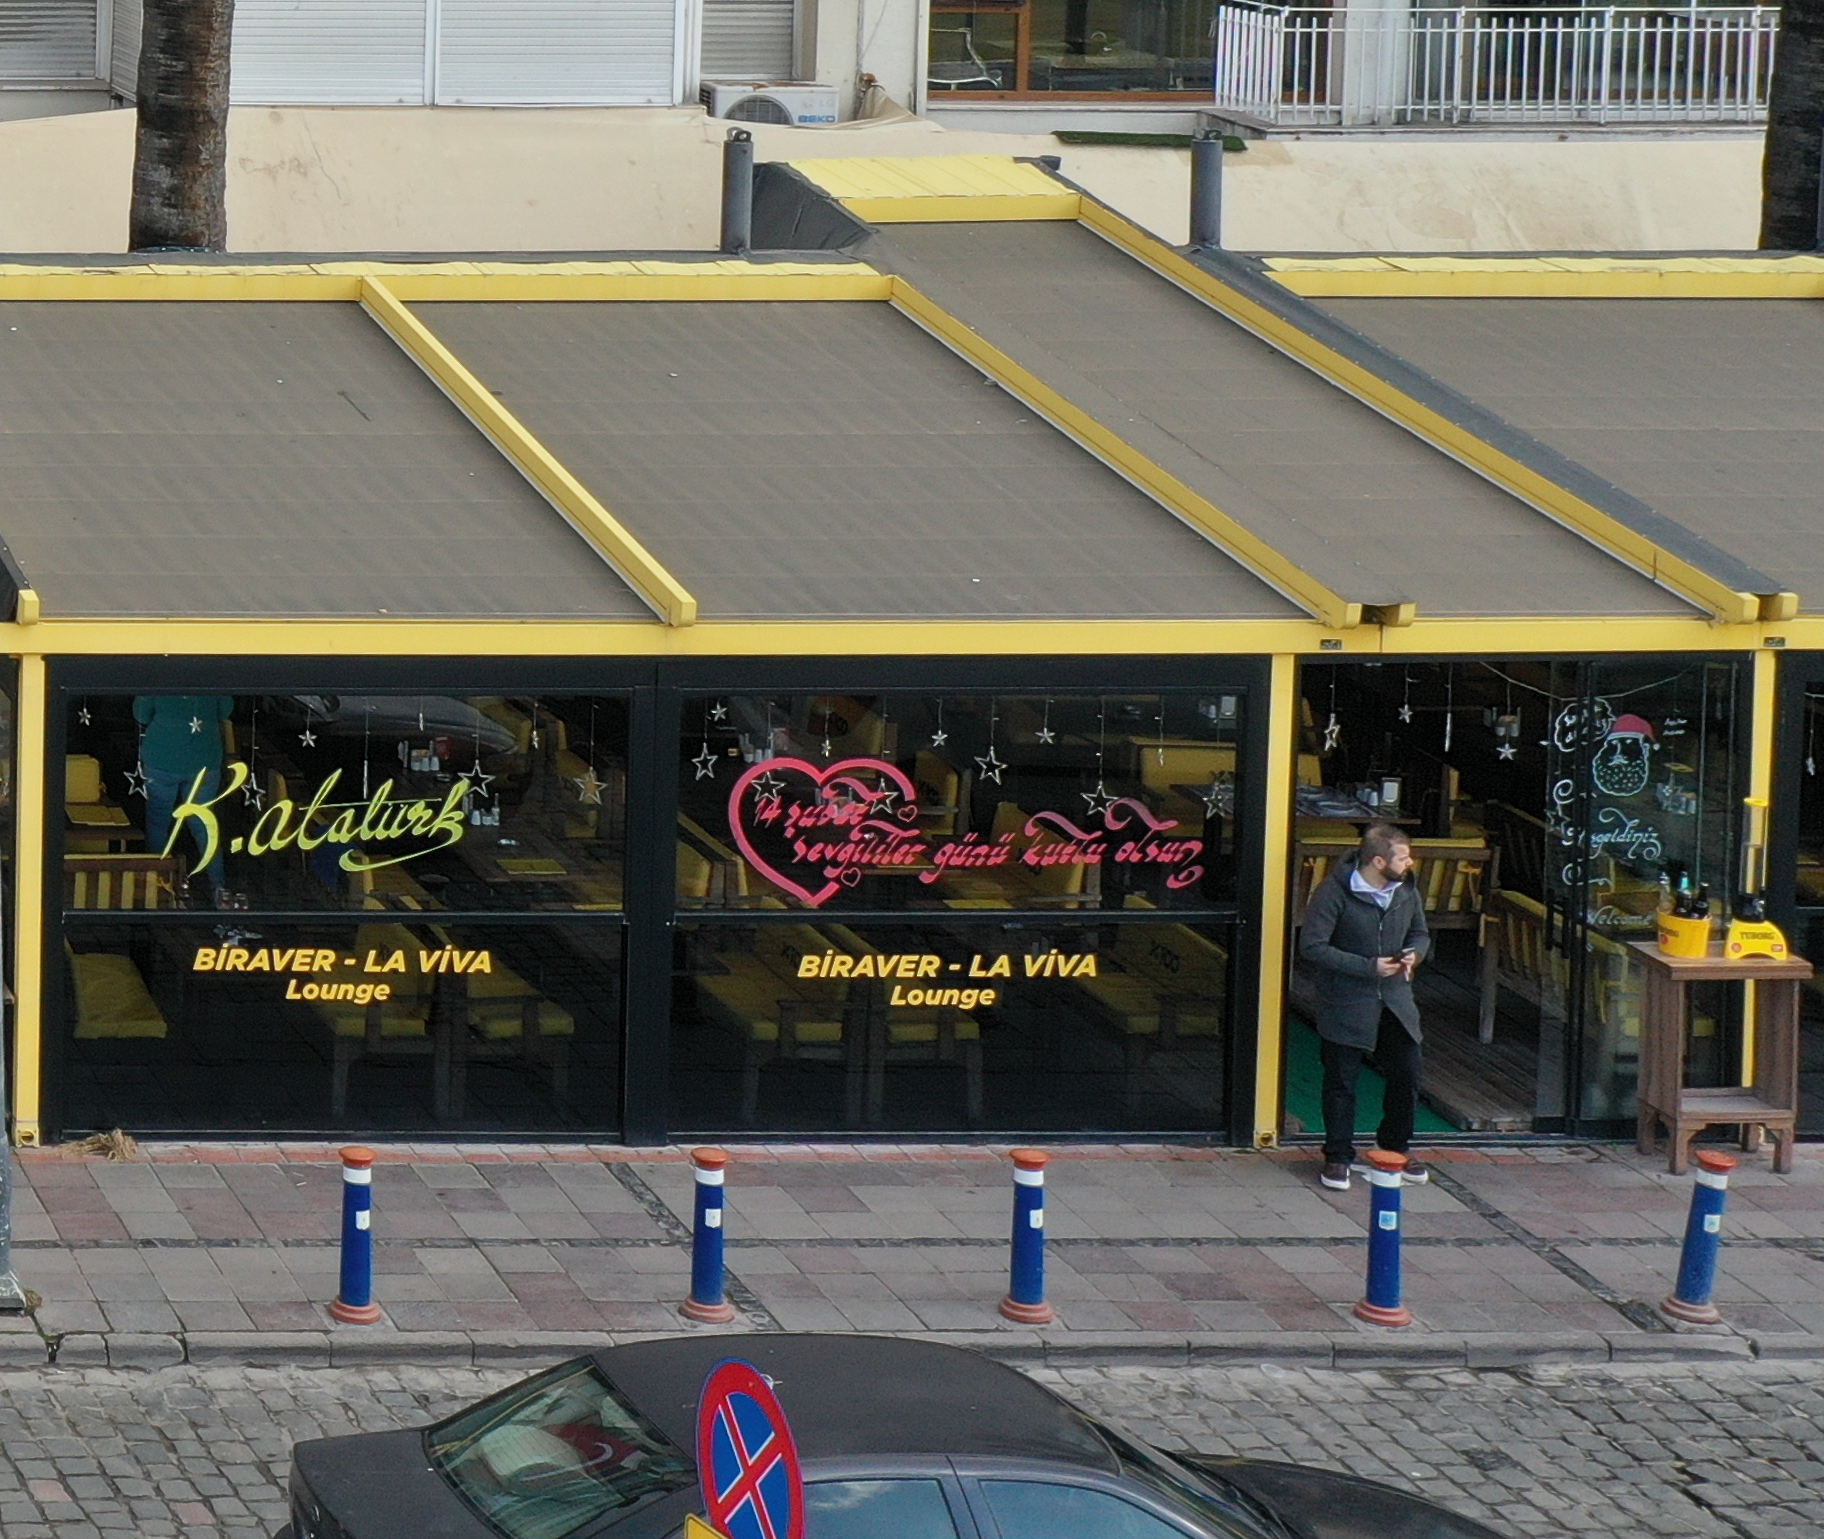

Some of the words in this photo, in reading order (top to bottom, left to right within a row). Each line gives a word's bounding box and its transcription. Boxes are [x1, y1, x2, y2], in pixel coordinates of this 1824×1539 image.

[797, 115, 836, 124] BEKO
[918, 832, 1016, 885] günü
[1104, 797, 1205, 890] olsun
[192, 943, 337, 973] BİRAVER
[363, 949, 406, 973] LA
[419, 944, 493, 973] VİVA
[797, 949, 942, 978] BİRAVER
[968, 954, 1011, 978] LA
[1023, 948, 1098, 978] VİVA
[285, 978, 391, 1005] Lounge
[890, 984, 997, 1010] Lounge
